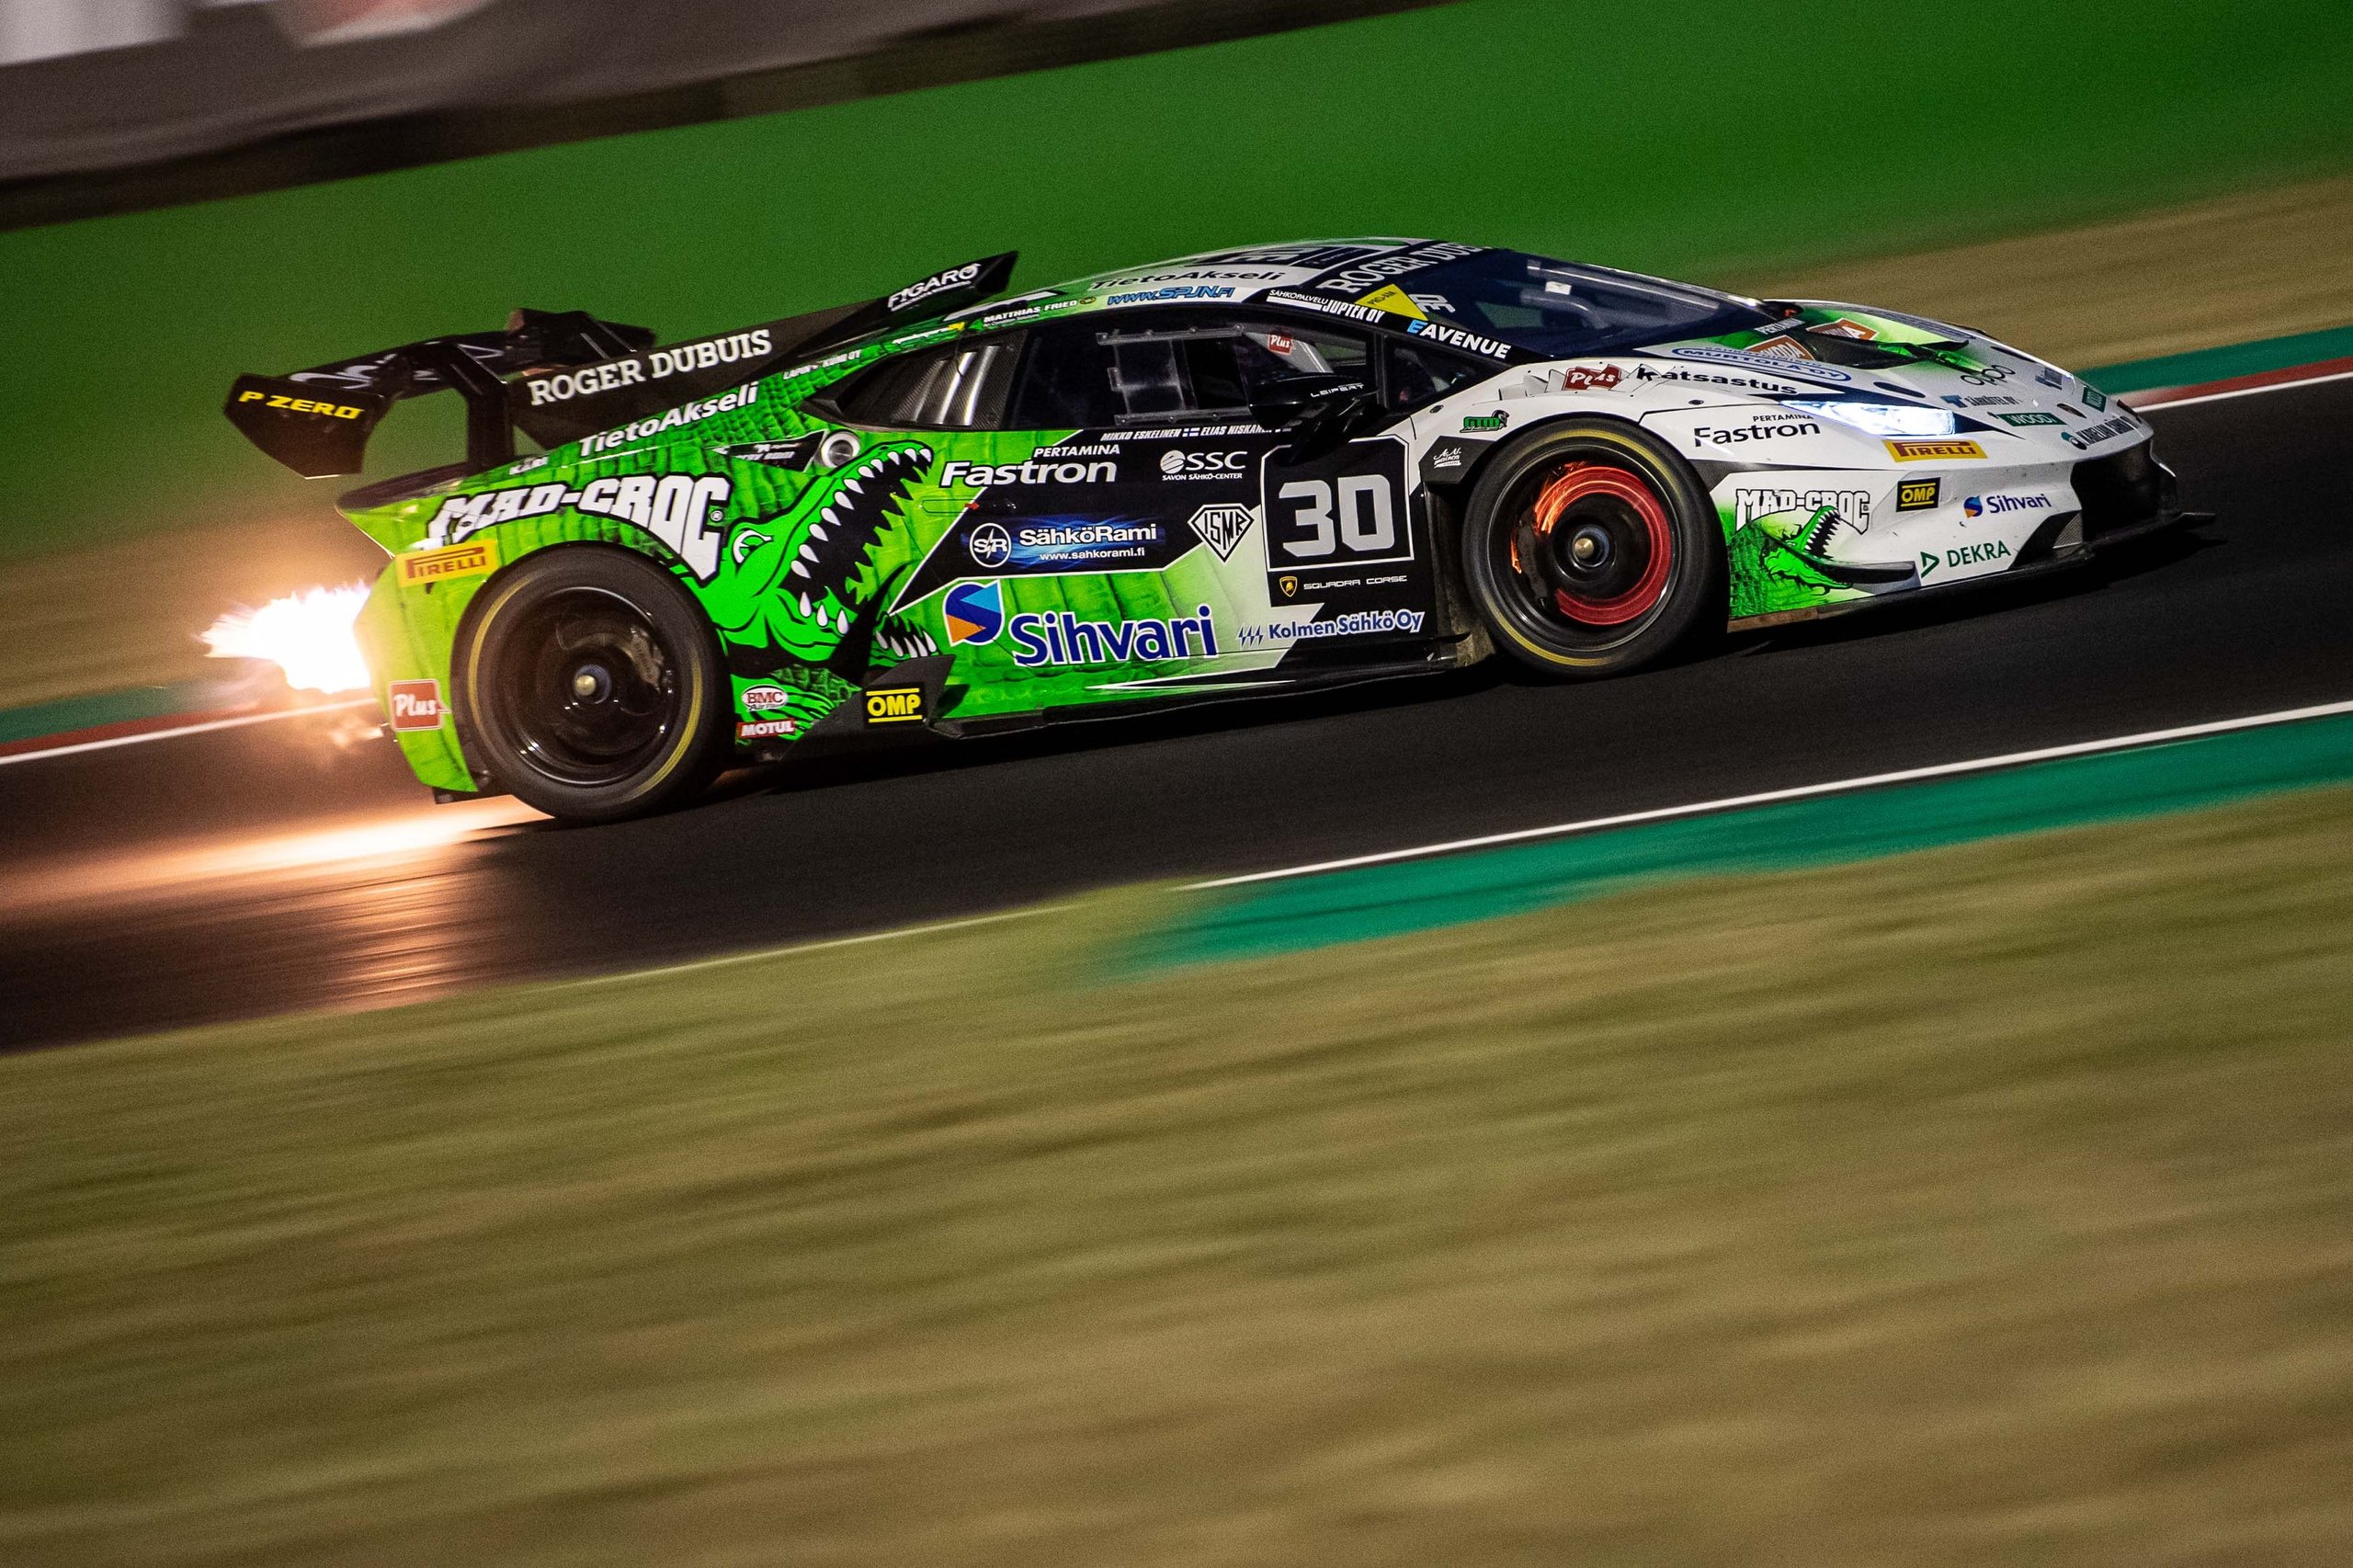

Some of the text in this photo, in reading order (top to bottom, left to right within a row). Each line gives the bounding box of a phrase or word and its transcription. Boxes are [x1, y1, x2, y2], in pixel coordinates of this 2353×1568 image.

[887, 263, 982, 308] FIGARO
[1088, 270, 1286, 290] TietoAkseli
[1316, 256, 1438, 294] ROGER
[983, 306, 1041, 324] MATTHIAS
[1044, 300, 1078, 311] FRIED
[1365, 309, 1386, 324] OY
[1270, 335, 1291, 348] Plus
[527, 329, 772, 406] ROGER DUBUIS
[238, 391, 365, 419] P ZERO
[578, 381, 759, 457] TietoAkseli
[1200, 426, 1227, 436] ELIAS
[1694, 422, 1821, 448] Fastron
[1033, 444, 1120, 458] PERTAMINA
[1185, 451, 1248, 471] SSC
[1892, 441, 1977, 457] PIRELLI
[940, 460, 1118, 488] Fastron
[1162, 473, 1187, 482] SAVON
[1901, 486, 1936, 503] OMP
[1986, 493, 2052, 515] Sihvari
[1279, 473, 1395, 558] 30
[1735, 488, 1871, 535] MAD-CROC
[415, 472, 733, 585] MAD-CROC
[1019, 523, 1157, 547] SähköRami
[405, 547, 487, 579] PIRELLI
[1040, 547, 1145, 562] www.sahkorami.fi
[1947, 540, 2011, 568] DEKRA
[1303, 574, 1407, 590] SQUADRA CORSE
[1011, 604, 1218, 665] Sihvari
[1268, 610, 1423, 641] Kolmen Sähkö Oy
[393, 693, 438, 717] Plus
[746, 691, 784, 704] BMC
[867, 694, 922, 717] OMP
[741, 721, 795, 736] MOTUL
